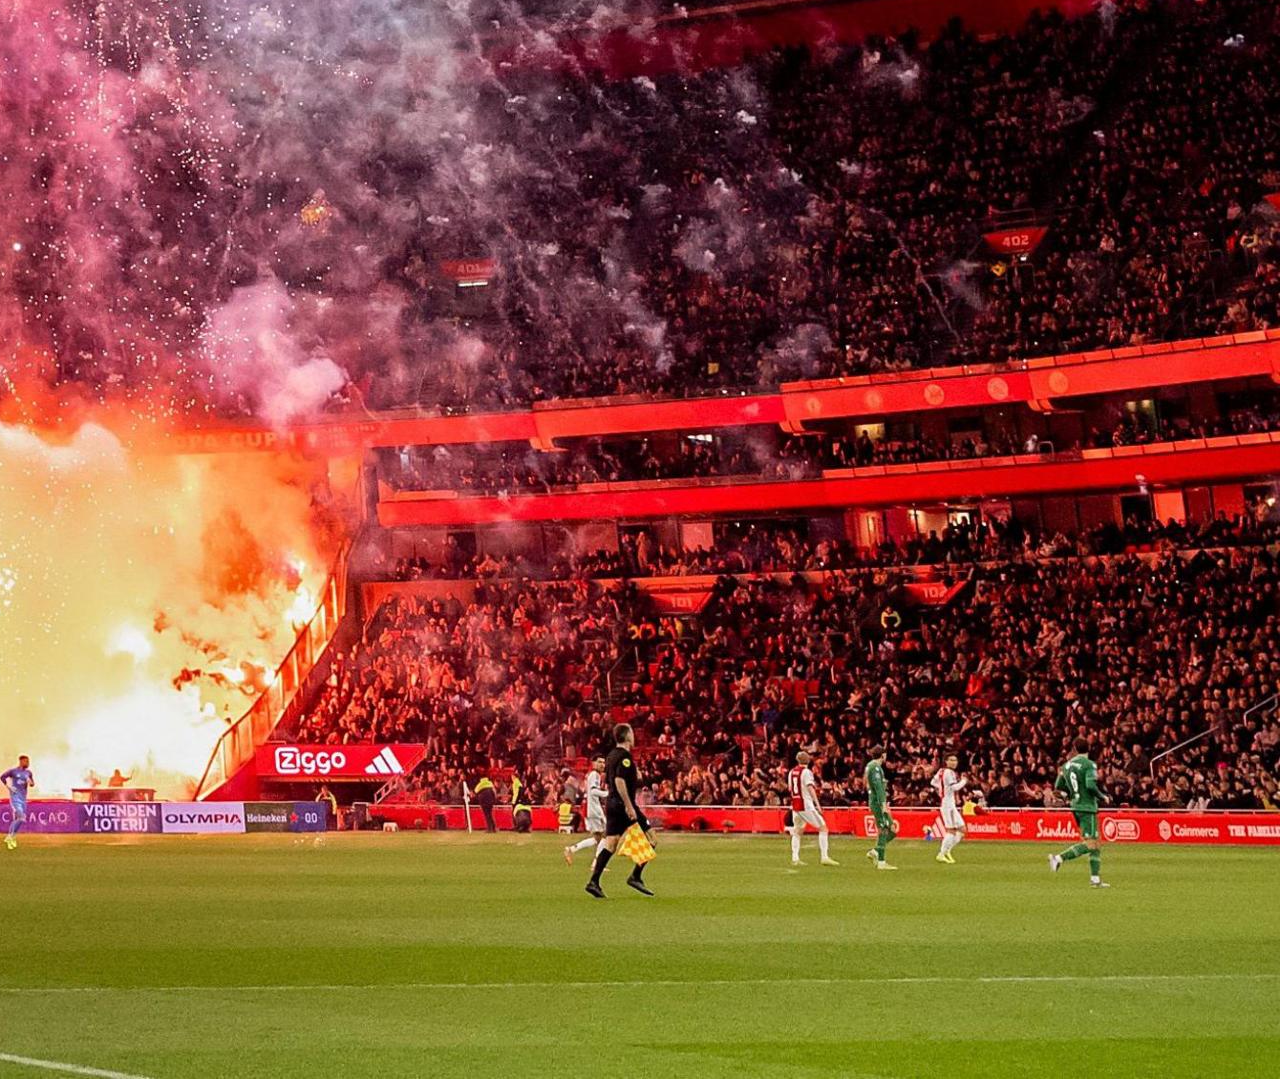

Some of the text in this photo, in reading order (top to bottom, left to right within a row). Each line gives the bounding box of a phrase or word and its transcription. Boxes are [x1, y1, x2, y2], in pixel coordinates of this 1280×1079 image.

[1002, 235, 1029, 247] 402
[84, 804, 157, 818] VRIENDEN
[165, 813, 242, 824] OLYMPIA
[247, 813, 288, 823] Heineken
[94, 818, 148, 832] LOTERIJ
[1036, 818, 1080, 838] Sandals
[1173, 824, 1219, 837] Coinmerce
